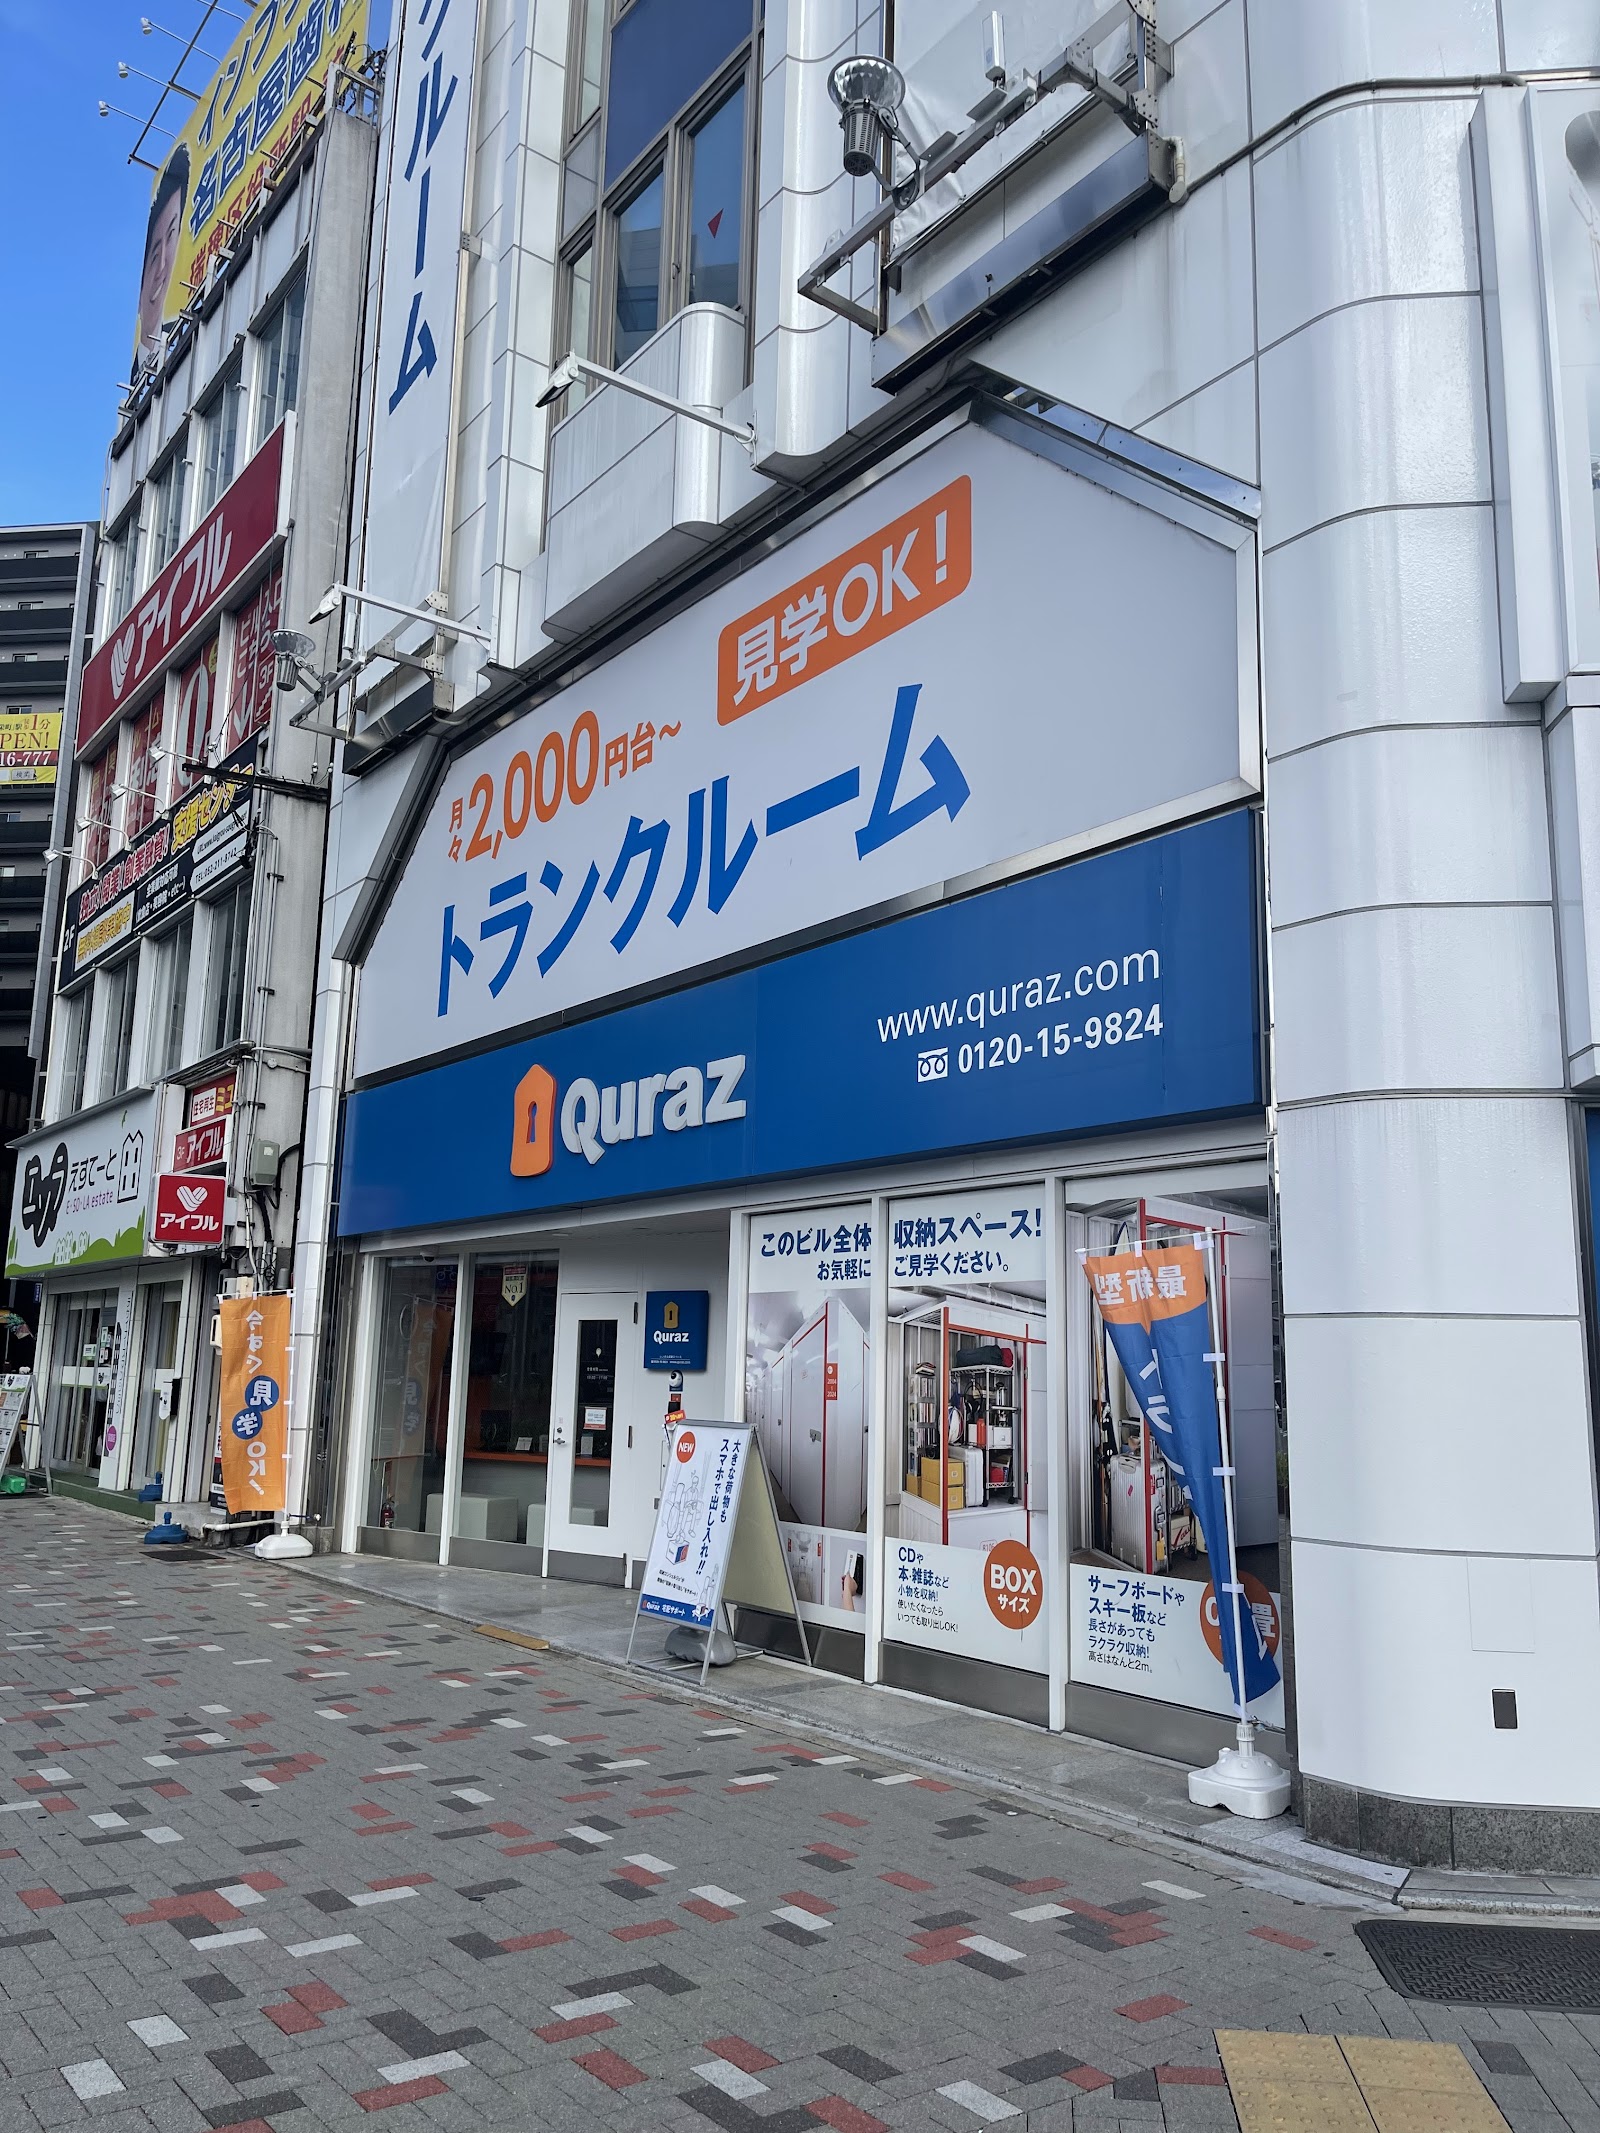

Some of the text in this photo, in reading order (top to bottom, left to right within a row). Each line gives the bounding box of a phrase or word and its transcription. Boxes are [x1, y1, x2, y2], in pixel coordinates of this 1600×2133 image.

[134, 511, 233, 681] アイフル
[732, 508, 949, 707] 見学OK!
[437, 683, 972, 1018] トランクルーム
[64, 924, 76, 953] 2F
[876, 948, 1160, 1043] www.quraz.com
[957, 1003, 1164, 1074] 0120-15-9824
[560, 1054, 747, 1164] Quraz
[187, 1125, 224, 1164] アイフル
[69, 1148, 117, 1193] えすてーと
[91, 1190, 113, 1208] estate
[160, 1213, 219, 1231] アイフル
[761, 1208, 1042, 1258] このビル全体 収納スペース!
[817, 1250, 1009, 1281] お気軽に ご見学ください。
[653, 1330, 689, 1344] Quraz
[678, 1442, 696, 1454] NEW
[720, 1439, 742, 1523] 大きな荷物も
[898, 1546, 924, 1564] CDや
[898, 1586, 939, 1602] 小物を収納!
[990, 1563, 1037, 1596] BOX
[1088, 1574, 1185, 1607] サーフボードや
[898, 1599, 944, 1616] 使いたくなったら
[998, 1594, 1030, 1614] サイズ
[1088, 1597, 1167, 1626] スキー板など
[1088, 1618, 1156, 1642] 長さがあっても
[1088, 1635, 1150, 1659] ラクラク収納!
